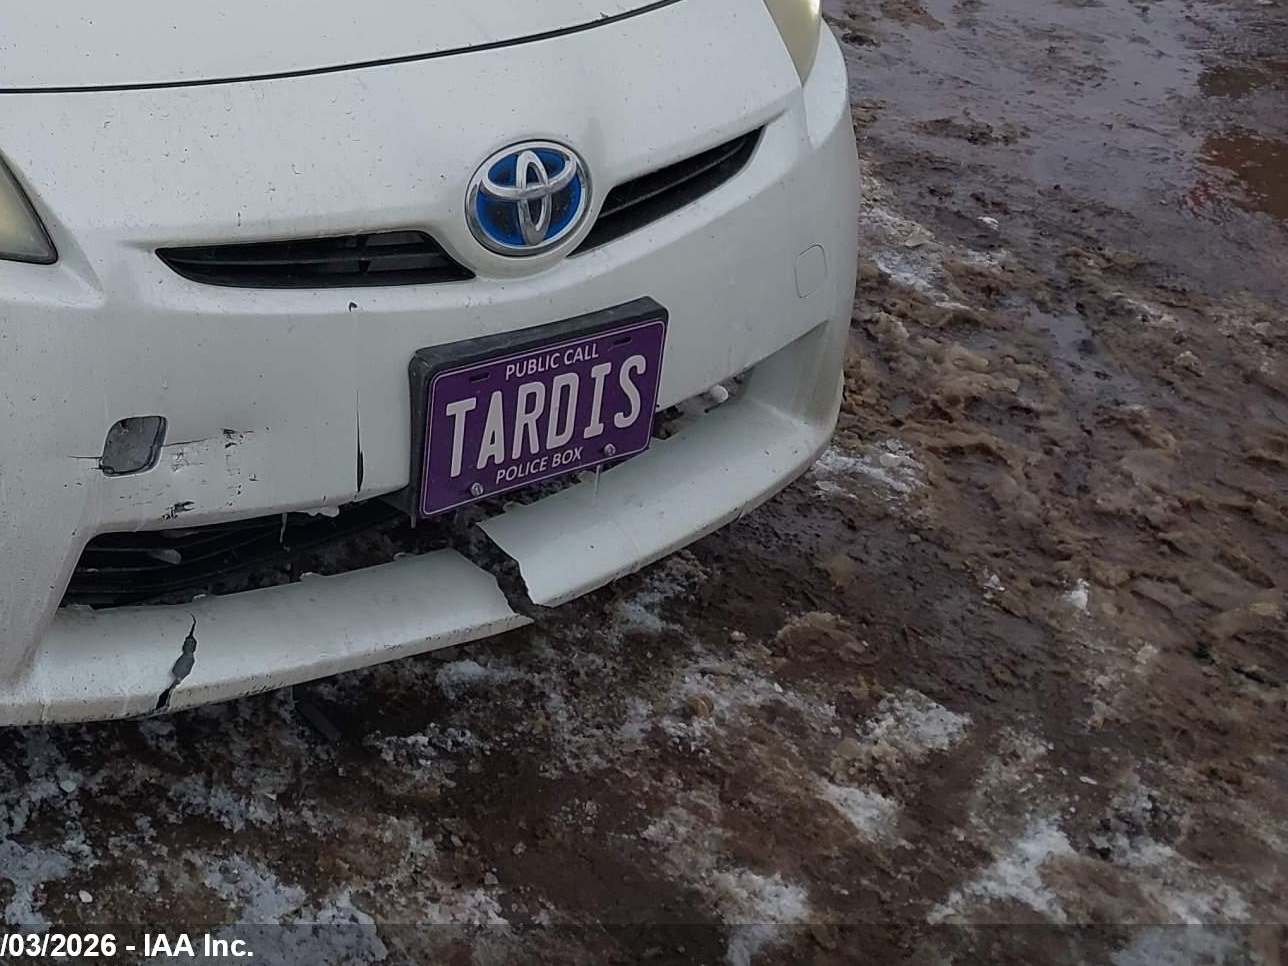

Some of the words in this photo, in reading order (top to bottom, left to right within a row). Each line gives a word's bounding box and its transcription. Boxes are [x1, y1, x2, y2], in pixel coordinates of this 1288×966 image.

[505, 352, 560, 381] PUBLIC
[563, 343, 600, 365] CALL
[445, 354, 647, 478] TARDIS
[495, 455, 549, 484] POLICE
[551, 446, 585, 467] BOX
